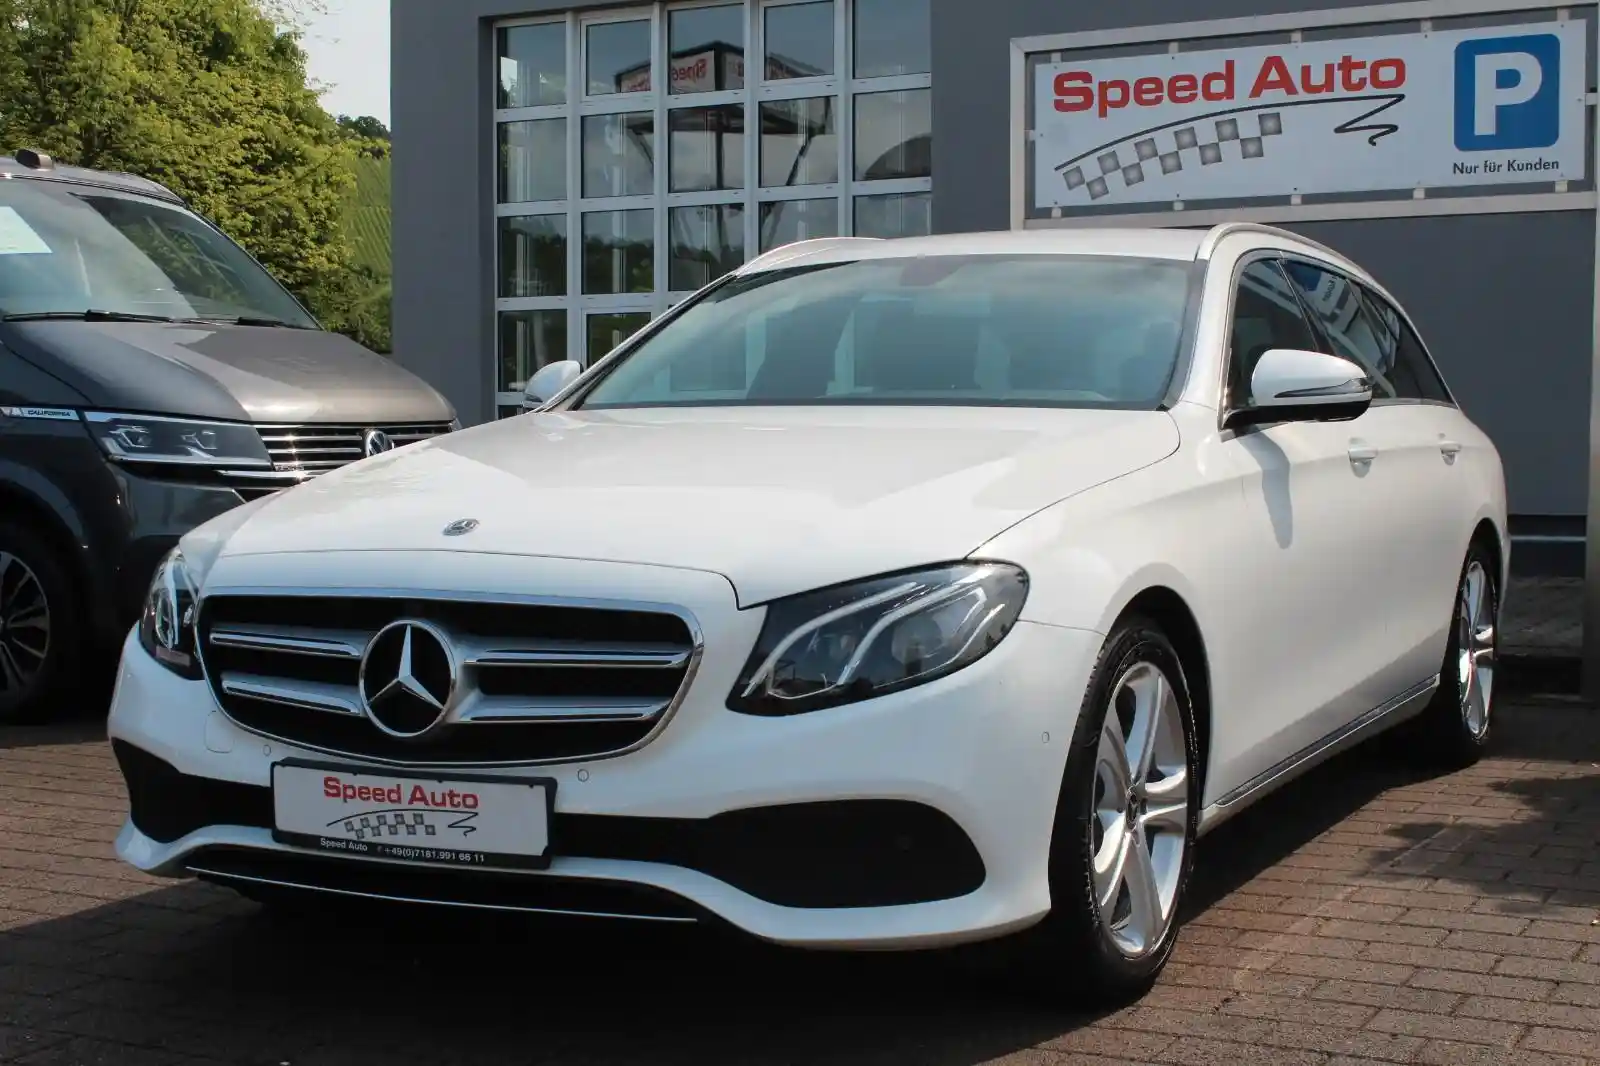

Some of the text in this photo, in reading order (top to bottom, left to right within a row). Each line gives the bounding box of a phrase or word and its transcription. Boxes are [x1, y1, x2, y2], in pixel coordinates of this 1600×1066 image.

[1053, 55, 1406, 118] Speed Auto
[1452, 157, 1560, 175] Nur für Kunden
[323, 776, 479, 809] Speed Auto
[320, 837, 346, 849] Speed
[348, 841, 368, 852] Auto
